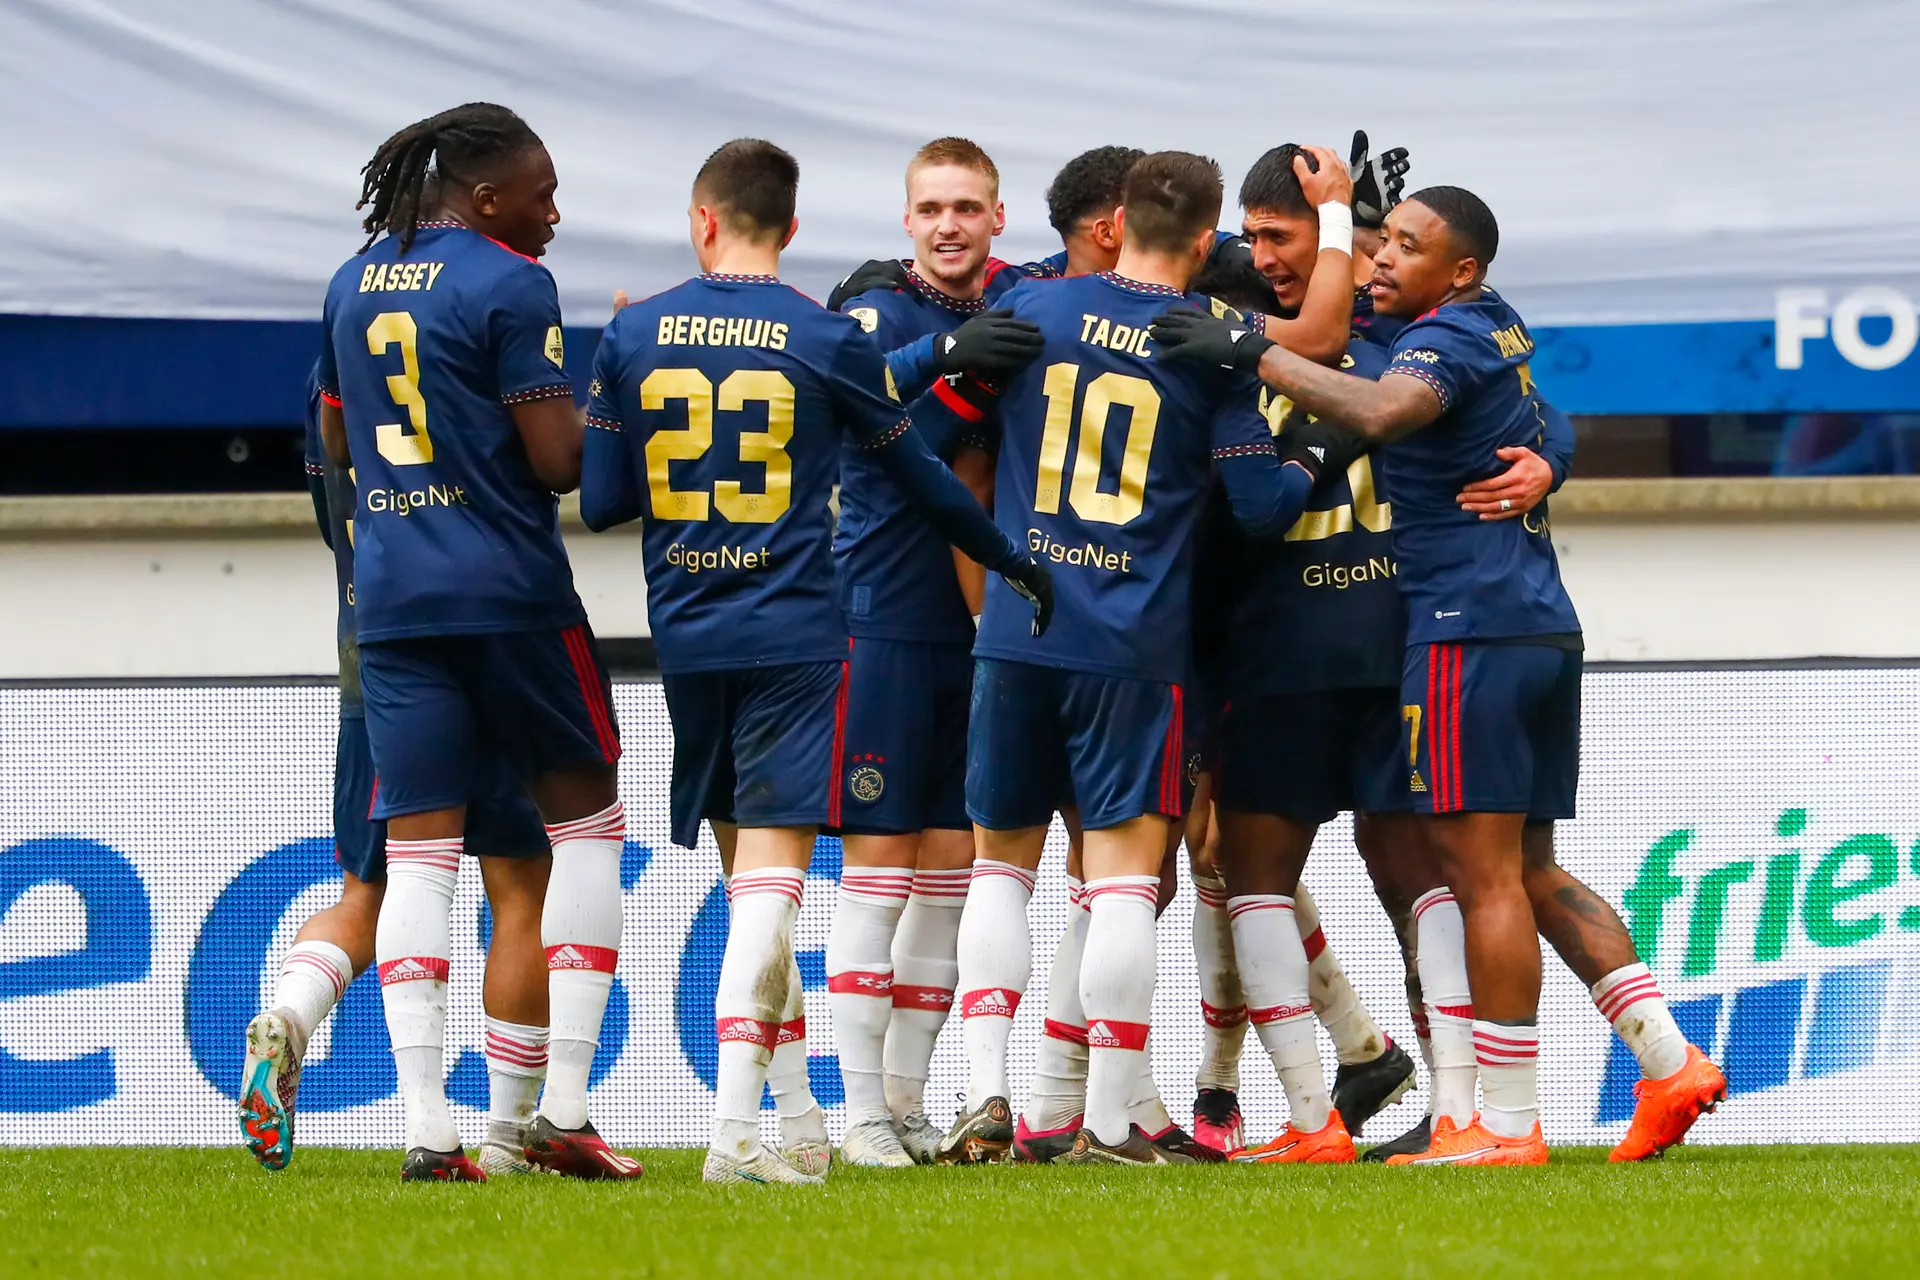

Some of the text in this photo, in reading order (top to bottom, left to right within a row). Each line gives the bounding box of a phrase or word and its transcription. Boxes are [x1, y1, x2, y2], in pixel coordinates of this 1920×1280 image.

[358, 262, 444, 293] BASSEY
[657, 315, 789, 351] BERGHUIS
[1775, 284, 1919, 371] FO
[366, 311, 434, 466] 3
[639, 367, 796, 524] 23
[1033, 361, 1162, 526] 10
[666, 542, 770, 574] GigaNet
[1026, 527, 1132, 573] GigaNet
[1403, 704, 1422, 767] 7
[383, 970, 435, 983] adidas
[548, 958, 592, 969] adidas
[968, 1002, 1011, 1016] adidas
[720, 1030, 766, 1044] adidas
